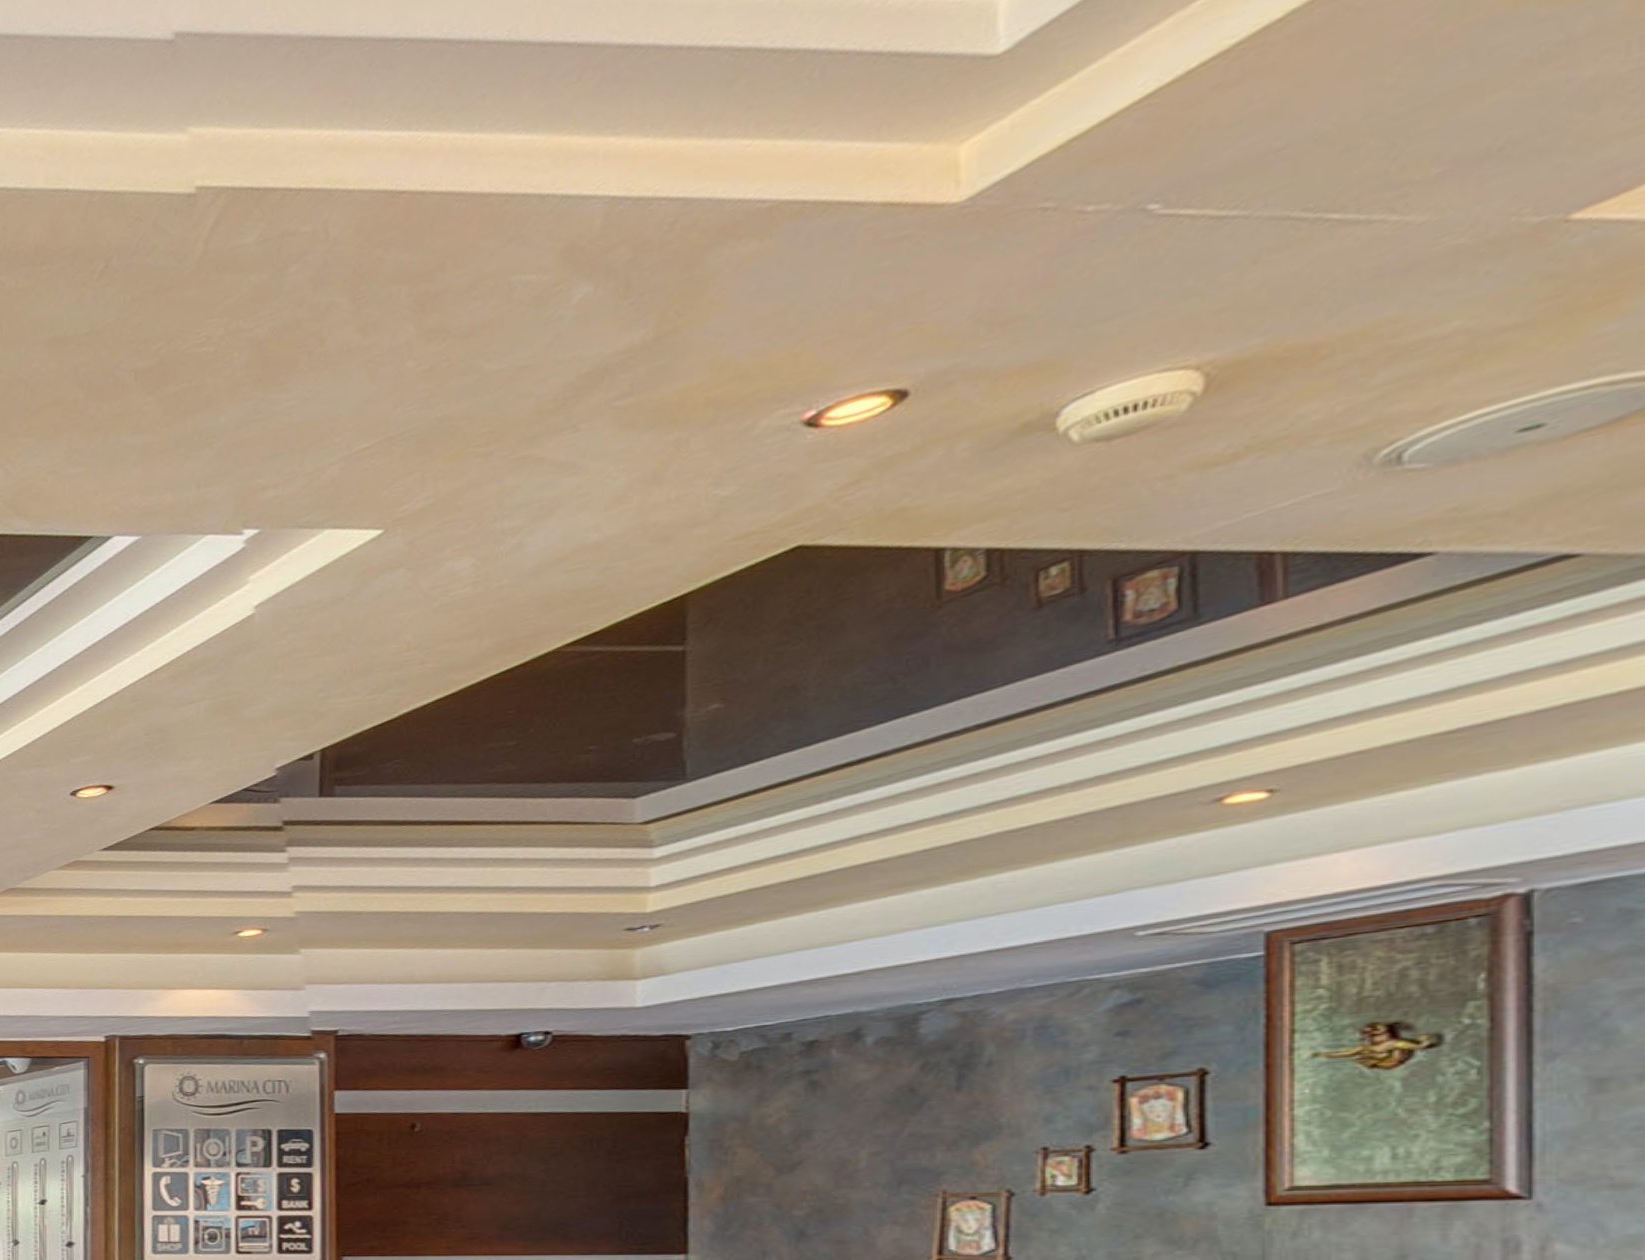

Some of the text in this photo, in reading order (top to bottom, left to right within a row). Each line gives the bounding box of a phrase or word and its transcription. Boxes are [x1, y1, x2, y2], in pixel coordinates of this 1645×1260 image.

[206, 1079, 290, 1095] MARINA CITY
[246, 1135, 265, 1164] P
[281, 1155, 308, 1165] RENT
[281, 1200, 309, 1209] BANK
[247, 1227, 260, 1236] TV
[156, 1243, 183, 1251] SHOP
[281, 1242, 309, 1251] POOL
